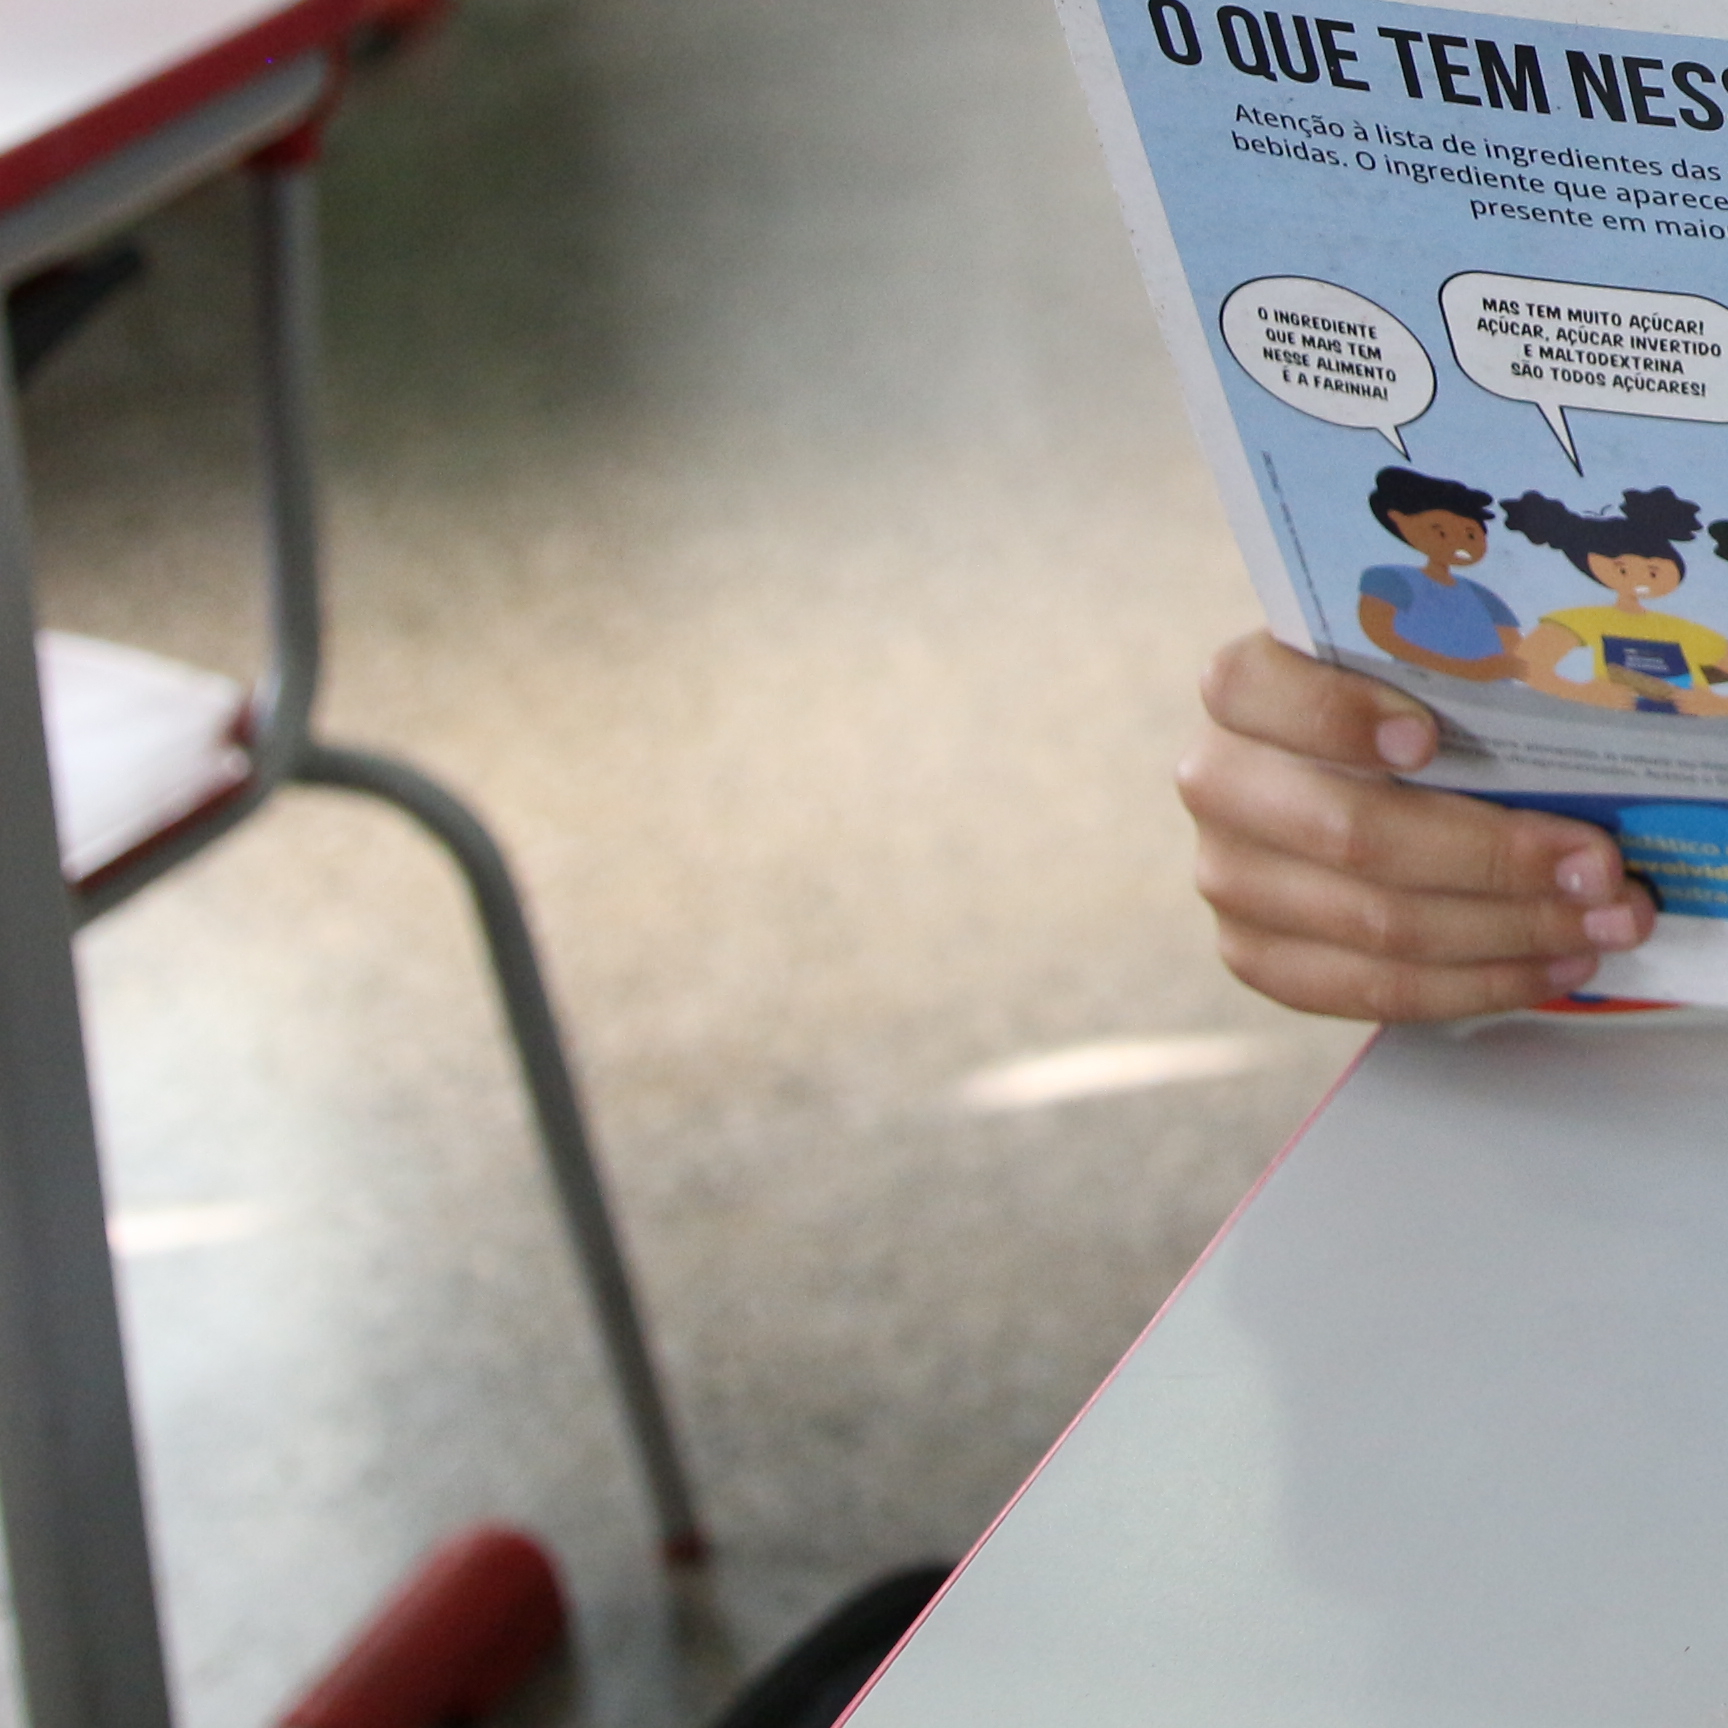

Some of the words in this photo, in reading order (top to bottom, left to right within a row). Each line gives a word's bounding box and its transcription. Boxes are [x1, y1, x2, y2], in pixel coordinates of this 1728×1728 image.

[1216, 5, 1371, 92] QUE
[1377, 26, 1551, 115] TEM
[1235, 103, 1345, 139] Atenção
[1353, 119, 1370, 143] à
[1374, 122, 1434, 152] lista
[1442, 132, 1477, 157] de
[1483, 137, 1663, 177] ingredientes
[1671, 157, 1722, 182] das
[1230, 129, 1348, 168] bebidas.
[1355, 150, 1377, 172] O
[1383, 153, 1546, 194] ingrediente
[1553, 180, 1607, 203] que
[1469, 198, 1594, 228] presente
[1601, 214, 1647, 233] em
[1257, 306, 1269, 321] O
[1273, 308, 1378, 341] INGREDIENTE
[1481, 296, 1521, 316] MAS
[1525, 302, 1562, 321] TEM
[1567, 307, 1623, 328] MUITO
[1628, 312, 1704, 336] AÇÚCAR!
[1265, 327, 1296, 346] QUE
[1301, 333, 1343, 355] MAIS
[1346, 341, 1382, 362] TEM
[1476, 315, 1550, 343] AÇÚCAR,
[1555, 324, 1624, 348] AÇÚCAR
[1629, 335, 1722, 358] INVERTIDO
[1262, 346, 1311, 368] NESSE
[1316, 356, 1397, 383] ALIMENTO
[1523, 343, 1533, 358] E
[1538, 345, 1685, 375] MALTODEXTRINA
[1282, 368, 1291, 383] É
[1297, 371, 1309, 387] A
[1313, 374, 1389, 402] FARINHA!
[1510, 360, 1544, 380] SÃO
[1549, 366, 1607, 387] TODOS
[1611, 372, 1706, 398] AÇÚCARES!
